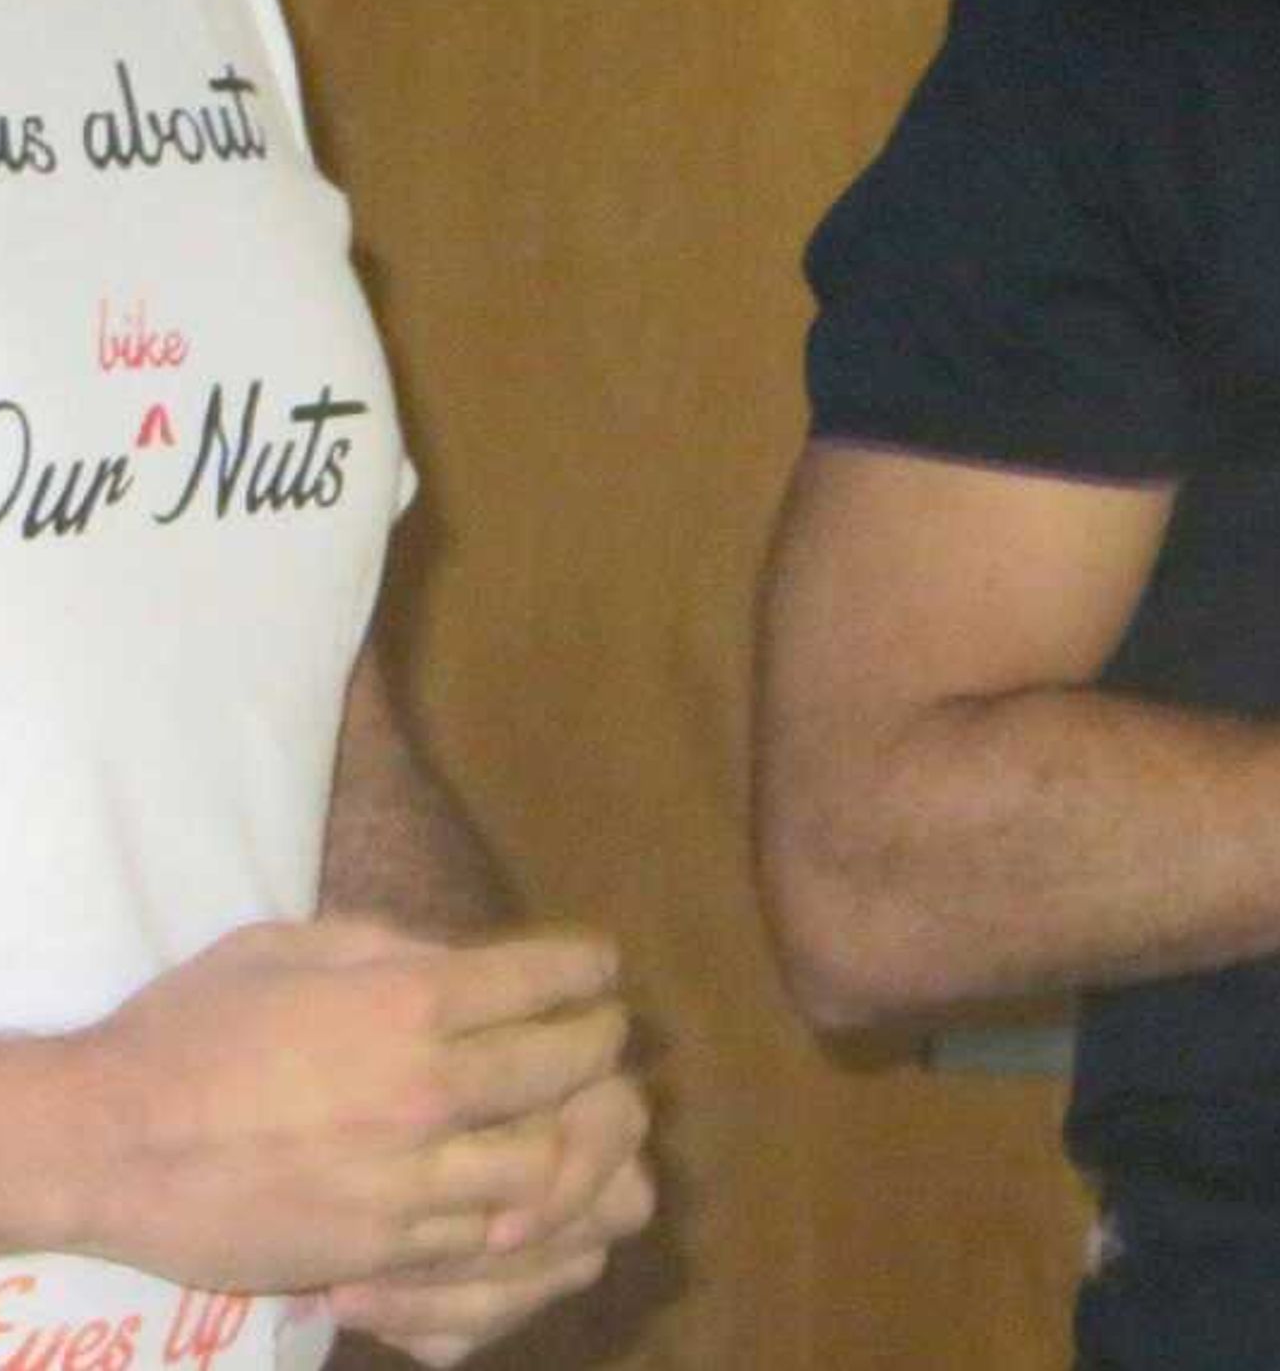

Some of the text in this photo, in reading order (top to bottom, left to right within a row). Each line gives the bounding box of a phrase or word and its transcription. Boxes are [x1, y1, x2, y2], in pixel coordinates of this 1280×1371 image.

[82, 60, 267, 171] about
[97, 297, 190, 372] bike
[154, 380, 367, 525] Nuts
